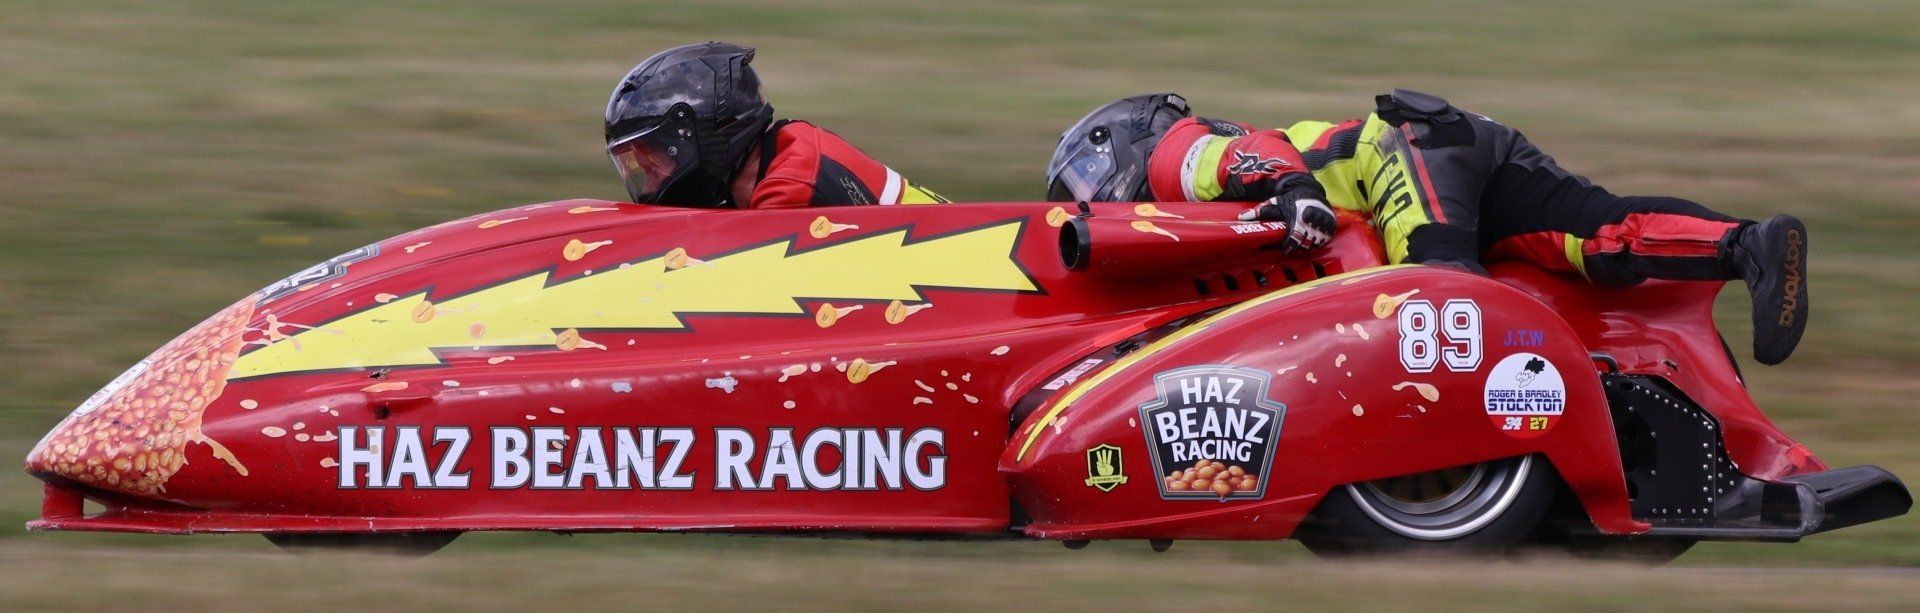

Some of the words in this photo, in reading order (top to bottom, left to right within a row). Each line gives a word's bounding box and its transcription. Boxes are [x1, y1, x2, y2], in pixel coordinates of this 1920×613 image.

[1398, 299, 1483, 373] 89
[1180, 376, 1244, 405] HAZ
[1488, 390, 1516, 398] ROGER
[1525, 390, 1561, 398] BRADLEY
[1488, 399, 1562, 411] STOCKTON
[1155, 406, 1270, 444] BEANZ
[1502, 416, 1523, 430] 34
[1529, 416, 1548, 430] 27
[337, 426, 471, 490] HAZ
[489, 426, 696, 490] BEANZ
[713, 426, 948, 491] RACING
[1171, 439, 1252, 463] RACING
